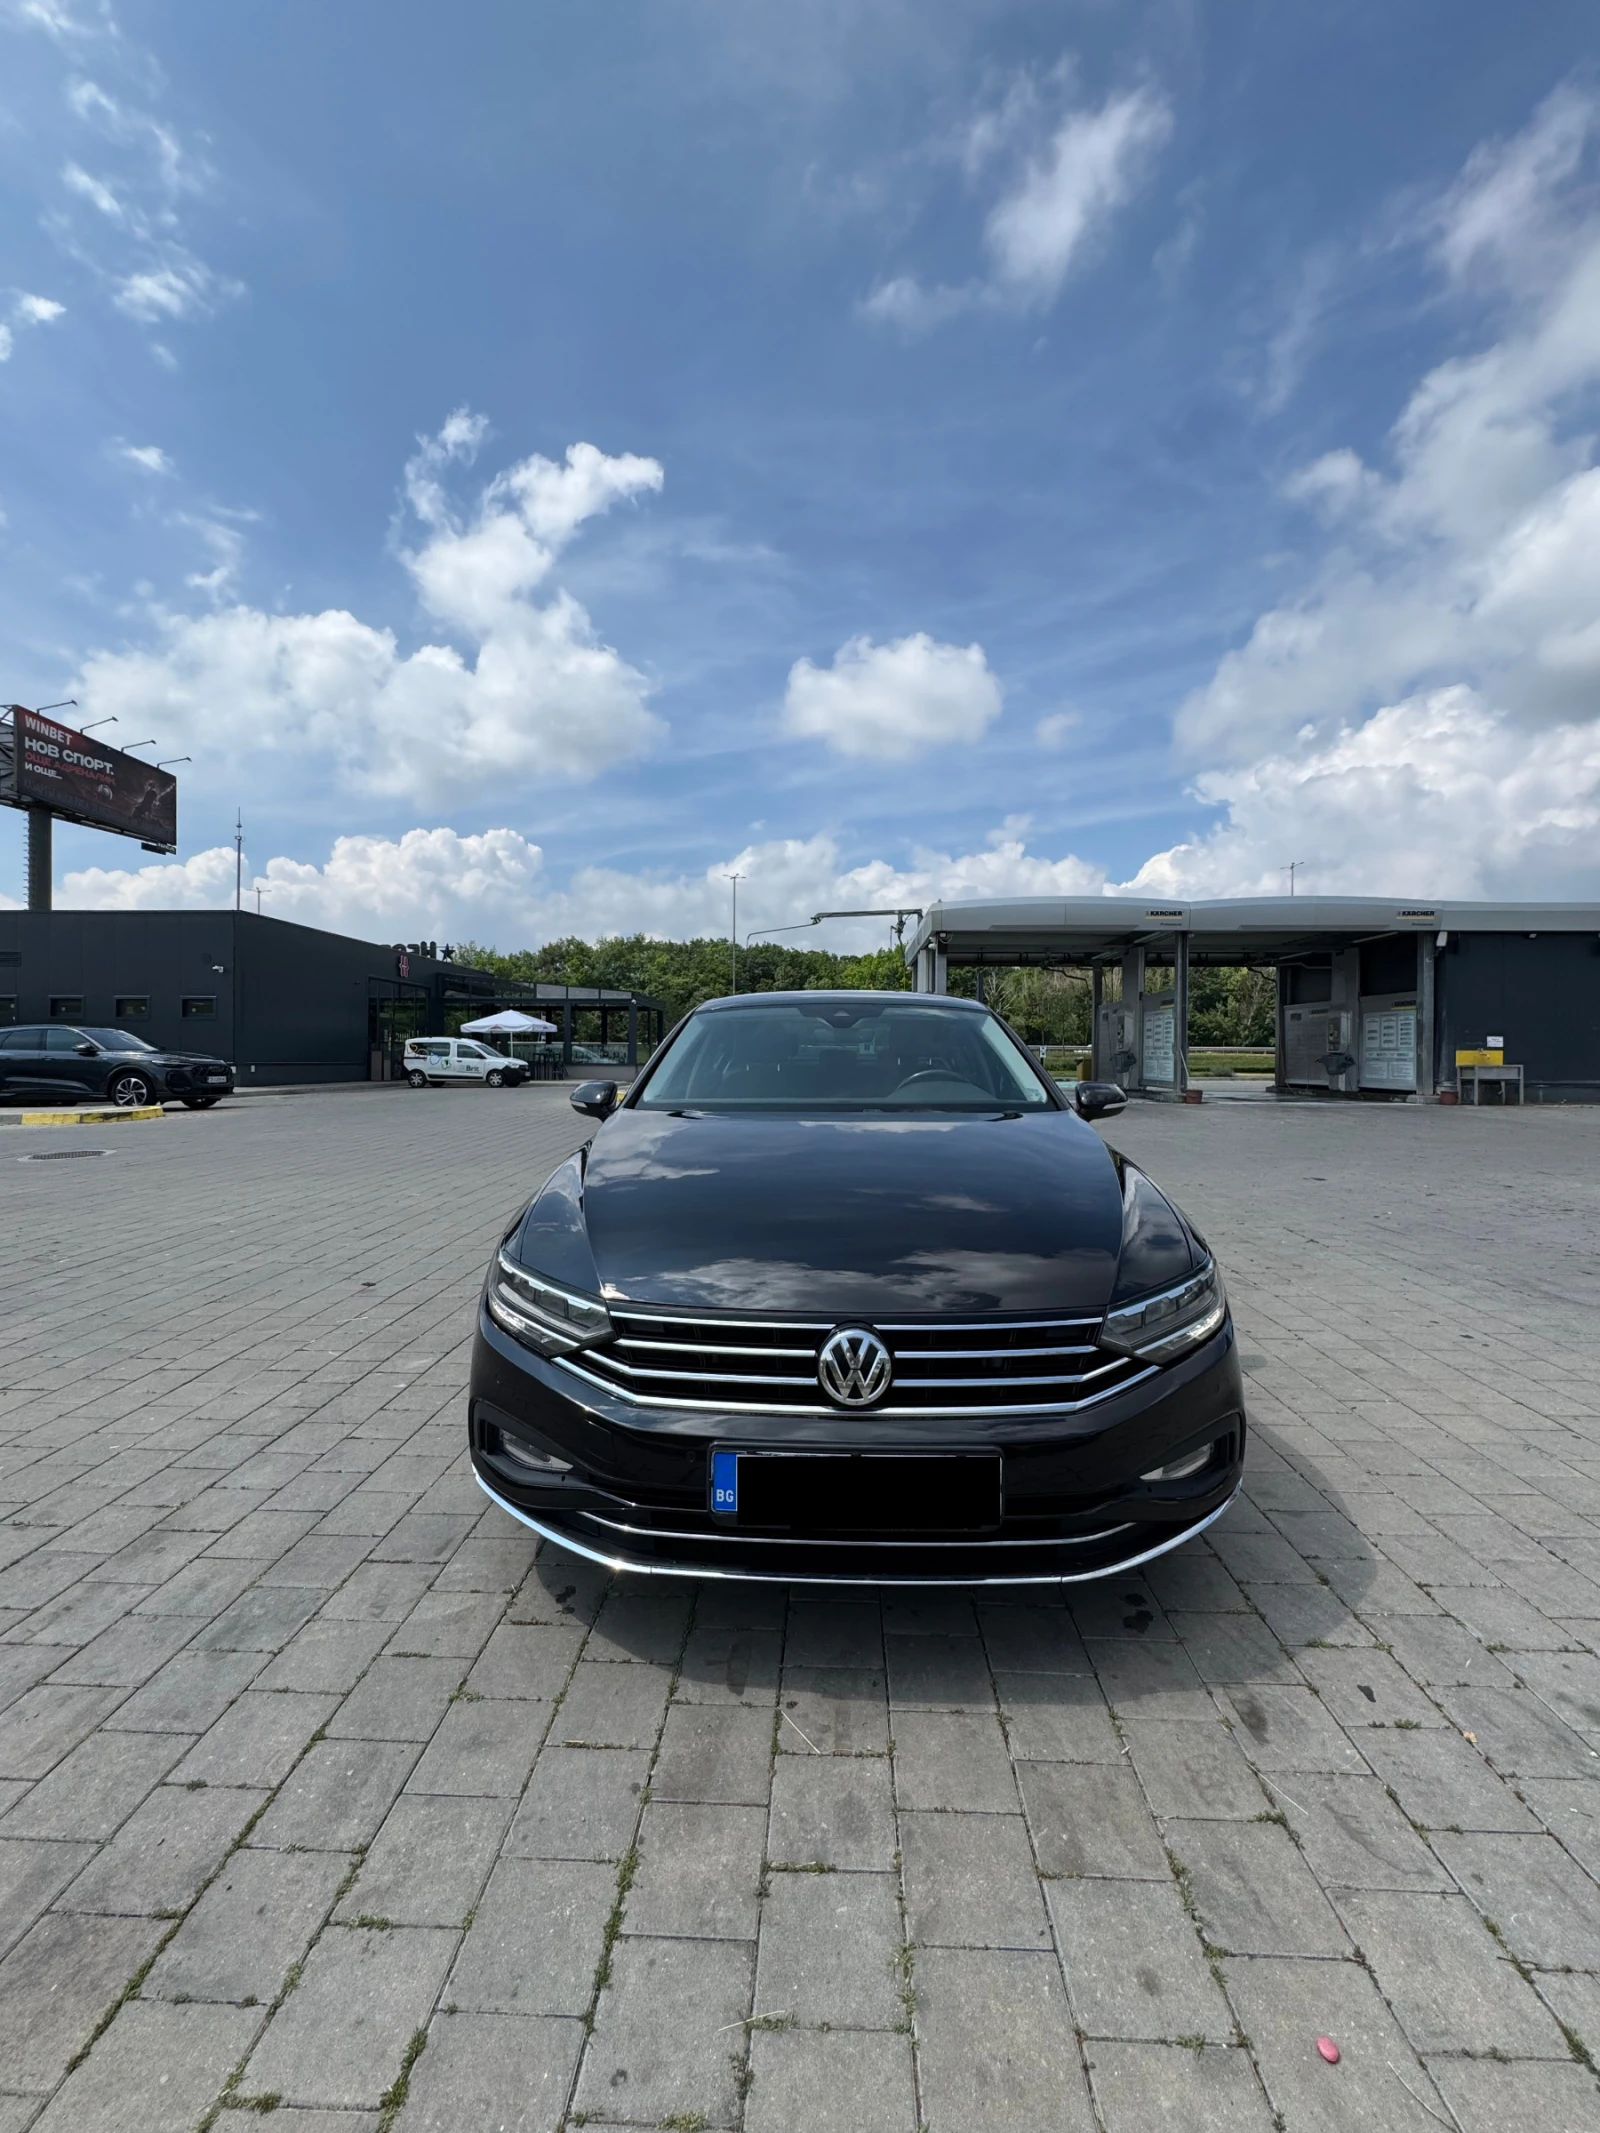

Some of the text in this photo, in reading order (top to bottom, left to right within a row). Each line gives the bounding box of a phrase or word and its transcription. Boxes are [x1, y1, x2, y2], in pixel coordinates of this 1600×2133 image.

[25, 715, 72, 745] WINBET
[24, 736, 114, 775] НОВ СПОРТ.
[24, 761, 33, 771] И
[820, 1331, 891, 1404] VW
[716, 1489, 734, 1502] BG
